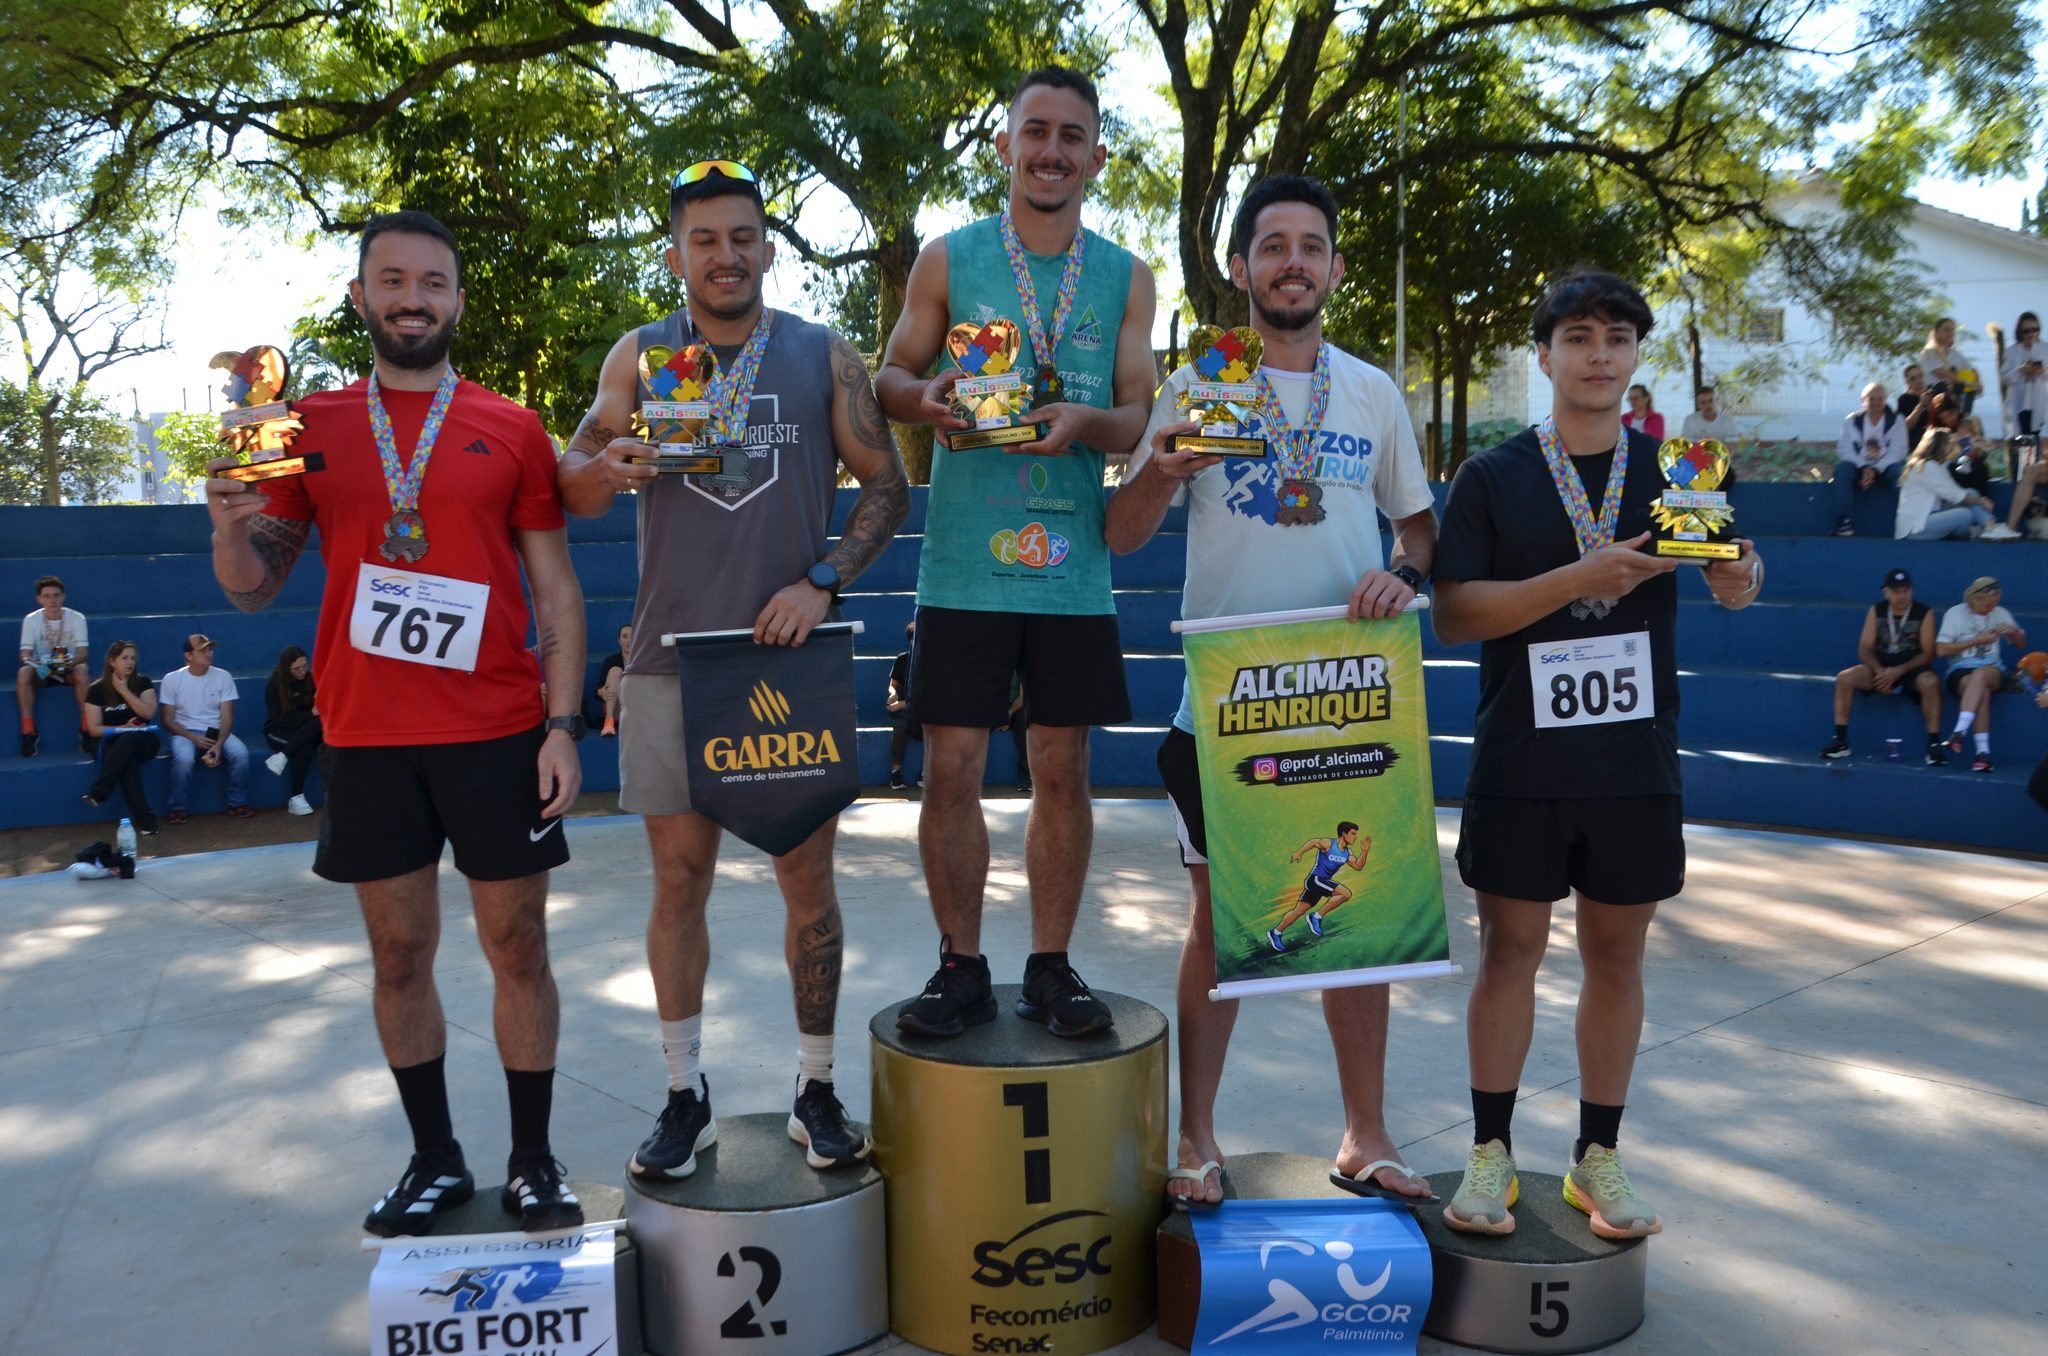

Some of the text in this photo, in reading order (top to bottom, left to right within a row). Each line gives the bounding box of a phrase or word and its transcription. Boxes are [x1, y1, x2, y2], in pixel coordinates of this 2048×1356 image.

[1071, 333, 1102, 345] ARENA
[959, 382, 1019, 394] Autismo
[1191, 390, 1254, 400] Autismo
[645, 409, 708, 418] Autismo
[1323, 456, 1370, 485] RUN
[1025, 496, 1075, 510] GRASS
[1666, 497, 1725, 507] Autismo
[371, 600, 466, 660] 767
[1231, 656, 1386, 702] ALCIMAR
[1550, 666, 1639, 720] 805
[1222, 688, 1387, 733] HENRIQUE
[703, 729, 841, 772] GARRA
[1279, 749, 1384, 774] @prof_alcimarh
[721, 768, 826, 783] centro de treinamento
[1283, 768, 1379, 783] TREINADOR DE CORRIDA
[1002, 1081, 1052, 1205] 1
[402, 1234, 592, 1262] ASSESSORIA
[970, 1296, 1112, 1327] Fecomércio
[1321, 1303, 1412, 1324] GCOR
[1528, 1280, 1570, 1338] 5
[387, 1306, 590, 1356] BIG FORT
[971, 1333, 1052, 1353] Senac
[1323, 1327, 1404, 1341] Palmitinho
